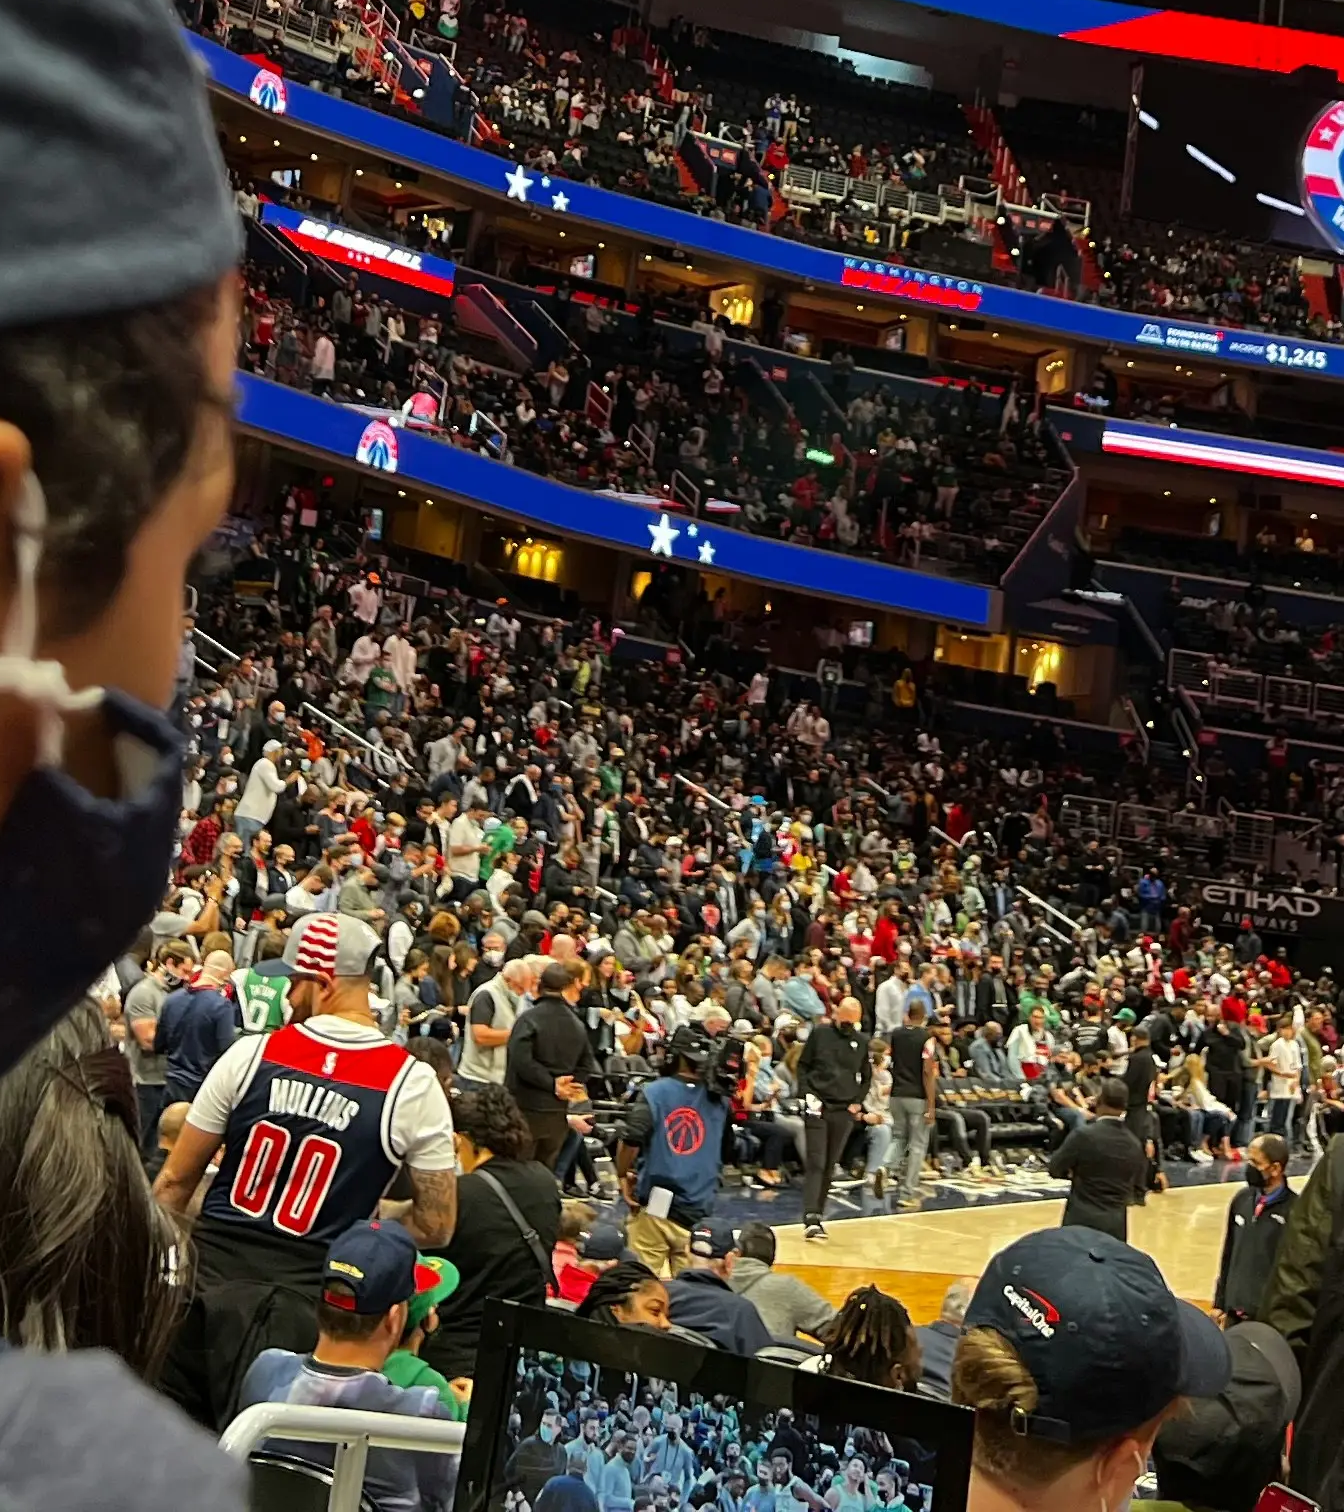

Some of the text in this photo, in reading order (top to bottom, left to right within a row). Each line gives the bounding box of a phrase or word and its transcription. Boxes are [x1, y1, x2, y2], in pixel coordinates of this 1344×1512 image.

[843, 257, 984, 295] WASHINGTON
[1265, 342, 1328, 370] $1,245
[1202, 884, 1321, 918] ETIHAD
[268, 1076, 361, 1134] MULLINS
[229, 1119, 343, 1238] 00
